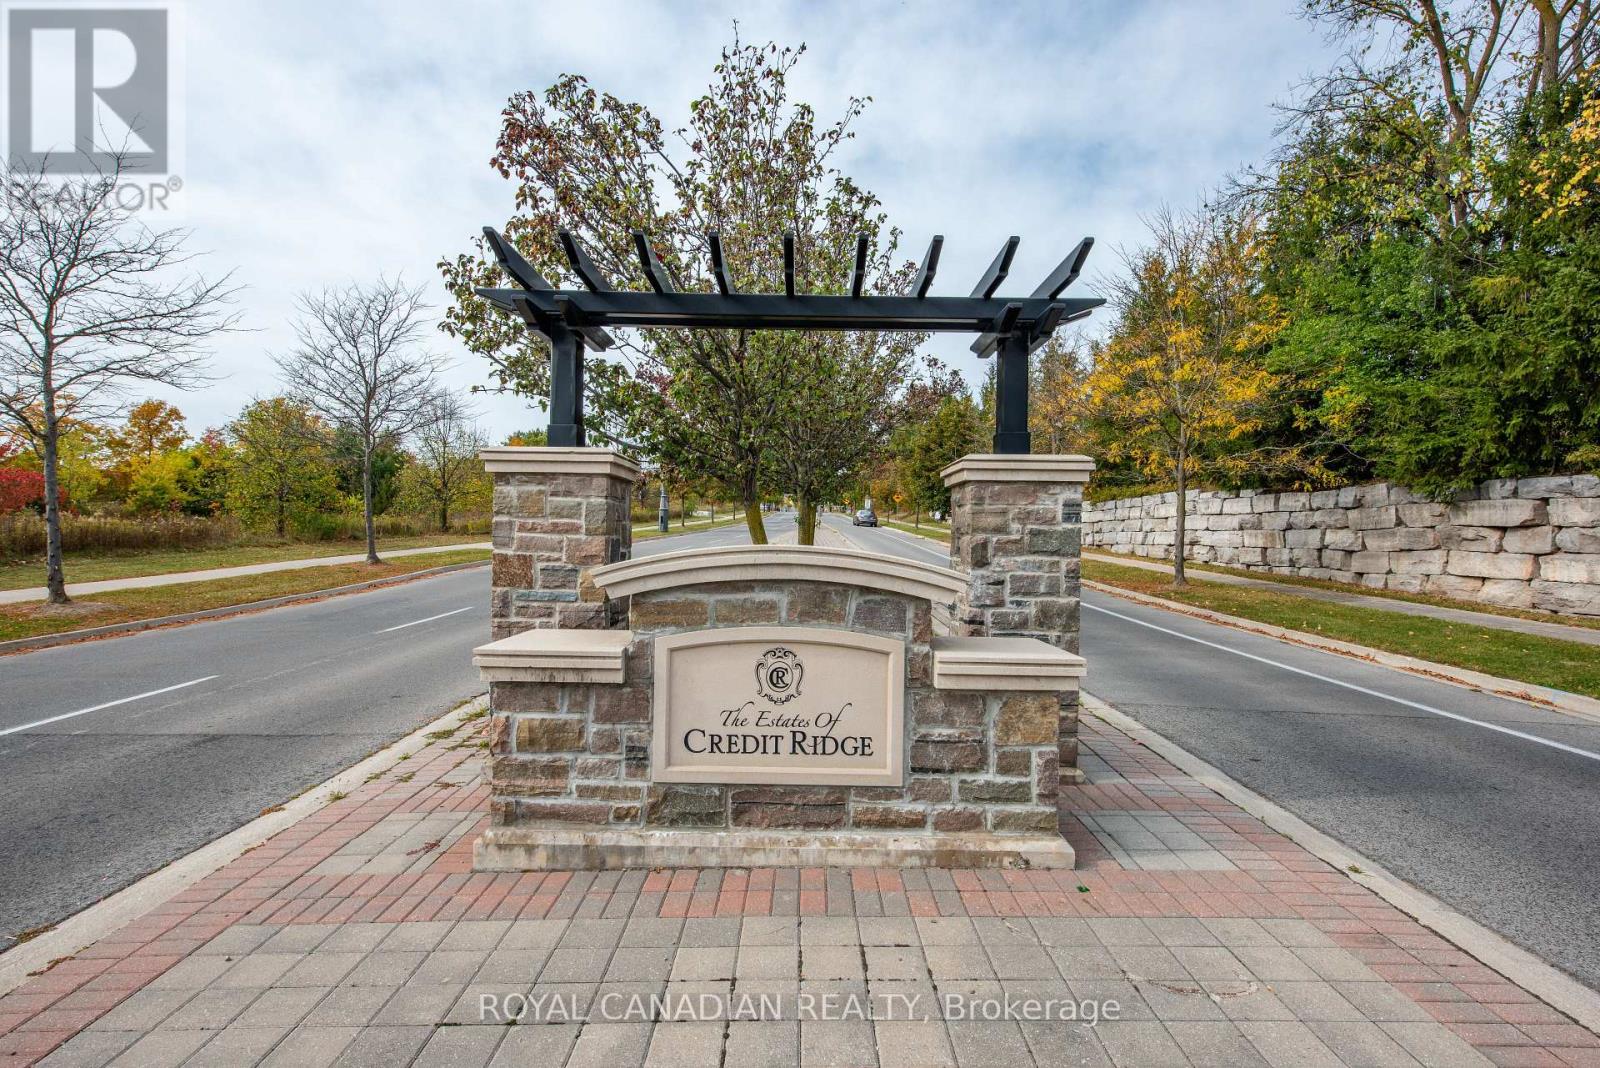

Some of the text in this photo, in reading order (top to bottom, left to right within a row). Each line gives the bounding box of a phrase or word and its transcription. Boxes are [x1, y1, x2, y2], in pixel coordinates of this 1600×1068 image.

[720, 701, 852, 742] The Estates Of
[684, 728, 874, 757] CREDIT RIDGE
